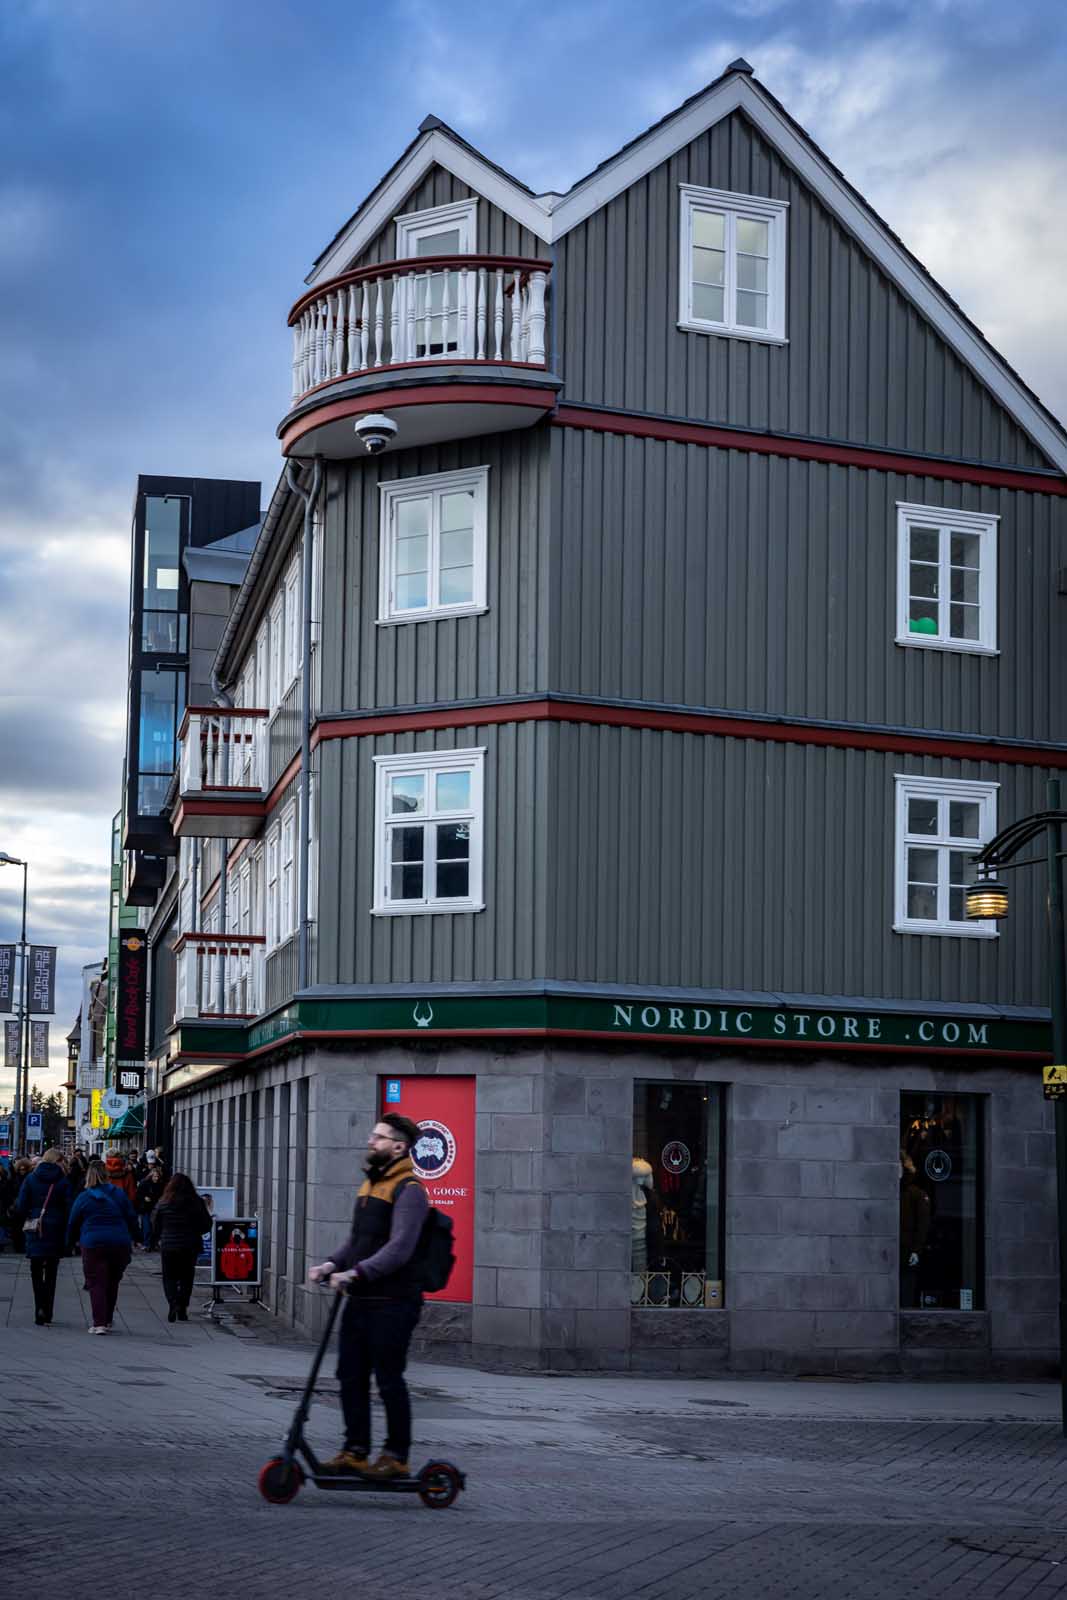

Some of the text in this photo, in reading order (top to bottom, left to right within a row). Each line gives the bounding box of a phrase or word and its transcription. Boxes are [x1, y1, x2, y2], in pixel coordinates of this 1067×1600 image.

[613, 1004, 989, 1044] NORDIC STORE .COM
[31, 1116, 38, 1125] P
[433, 1187, 468, 1197] GOOSE
